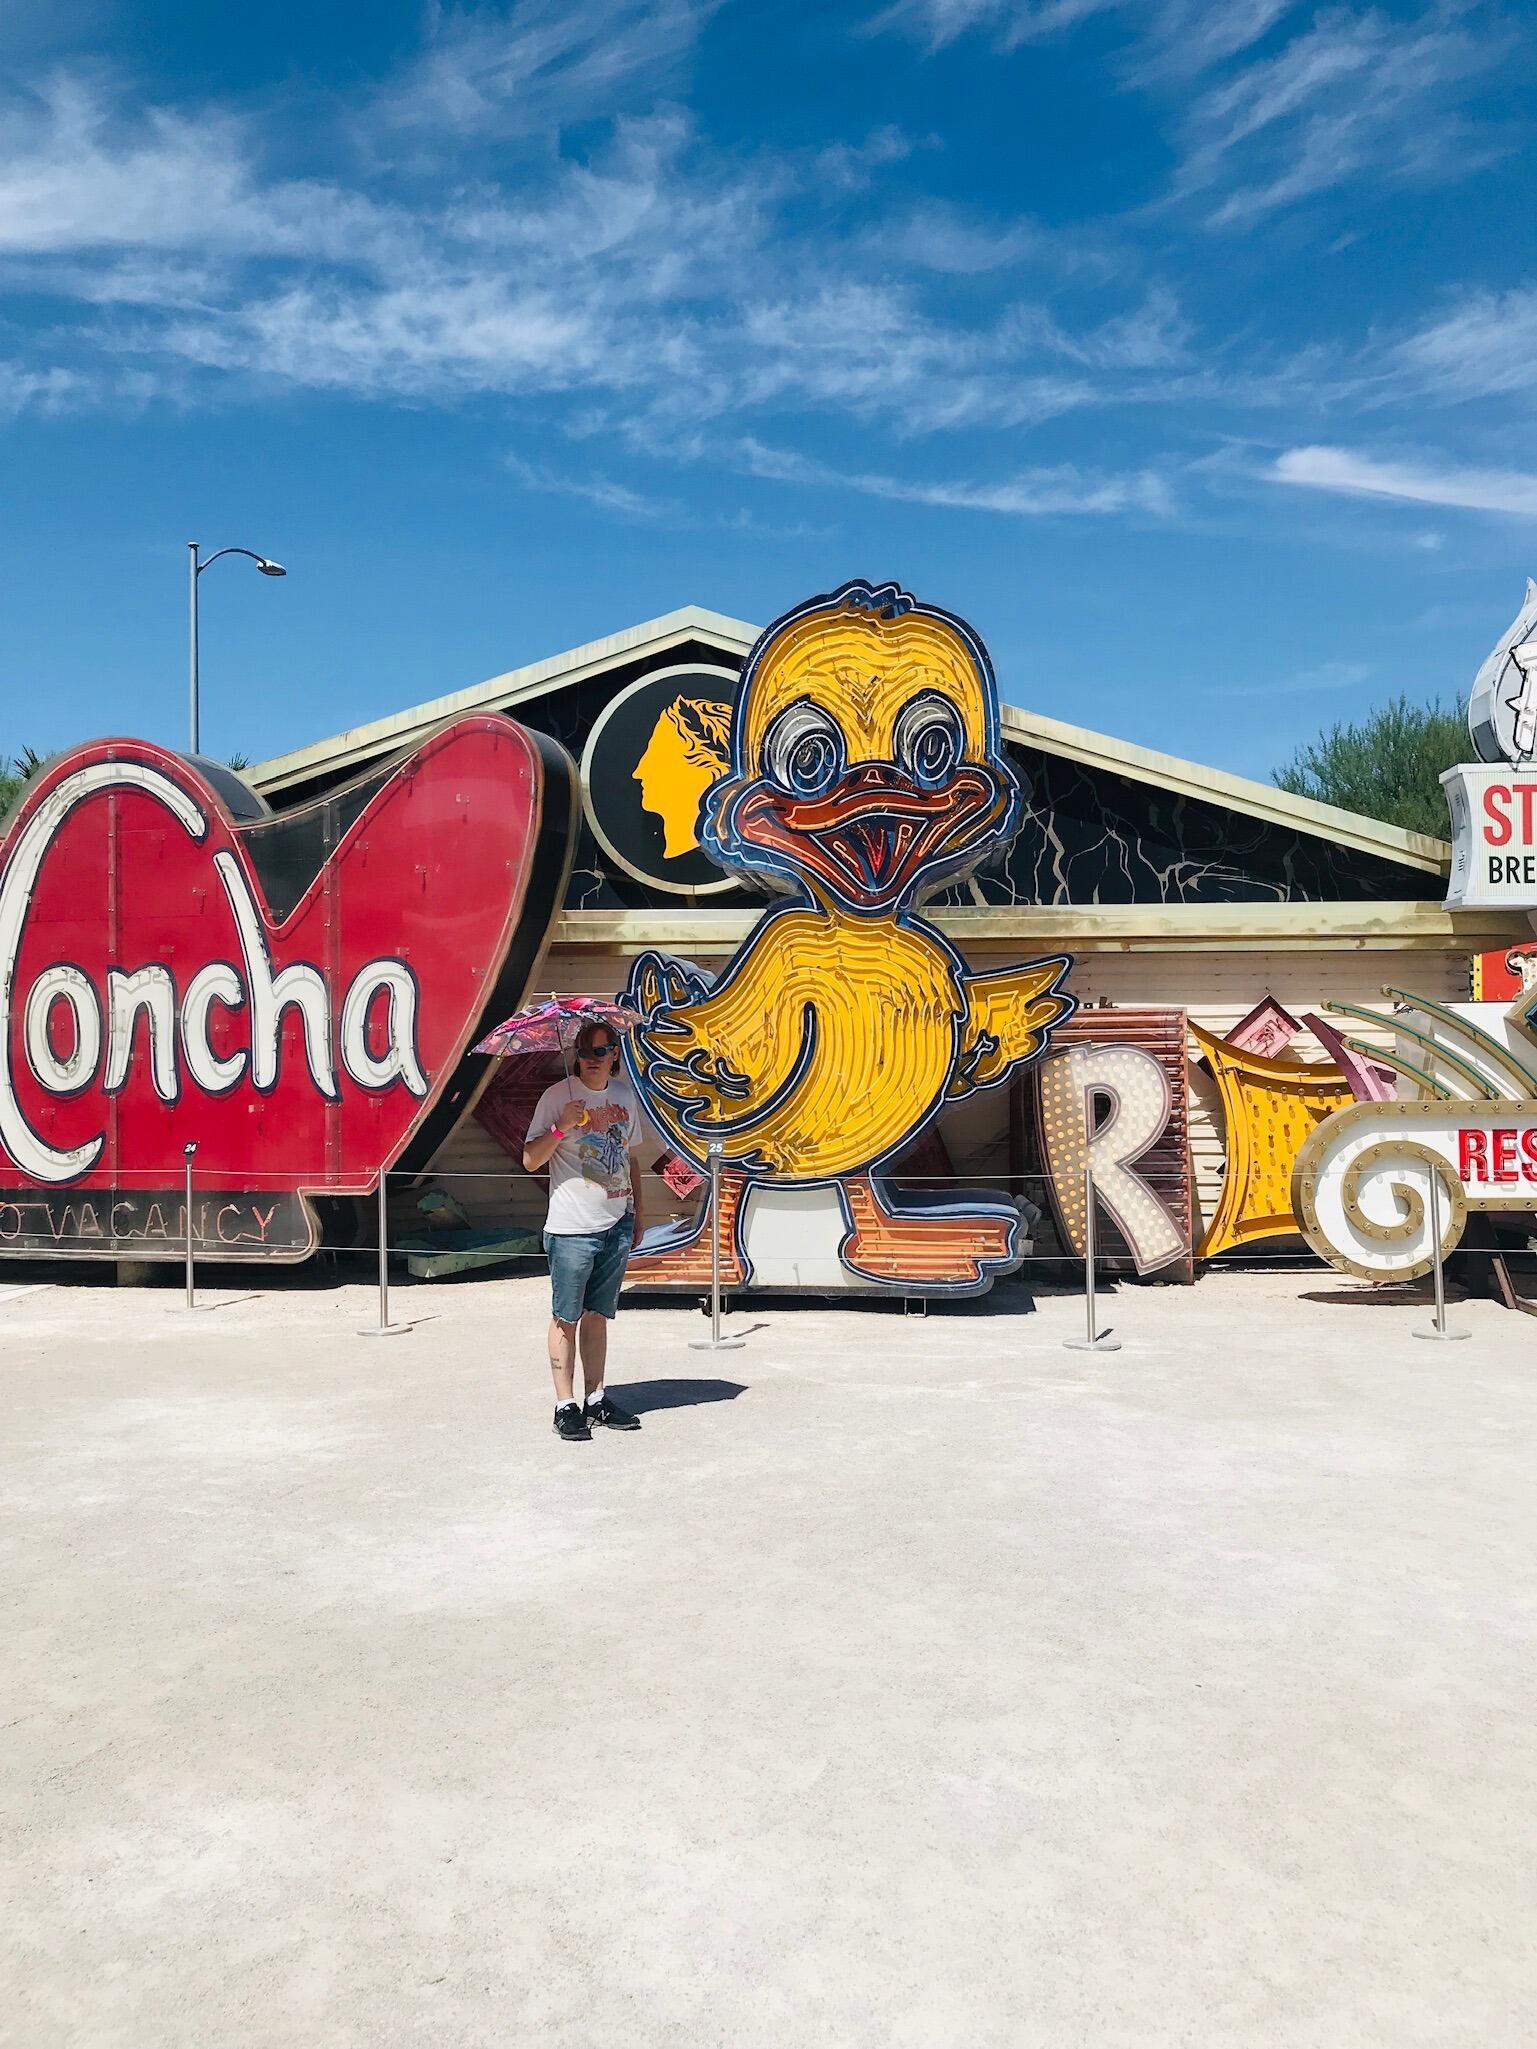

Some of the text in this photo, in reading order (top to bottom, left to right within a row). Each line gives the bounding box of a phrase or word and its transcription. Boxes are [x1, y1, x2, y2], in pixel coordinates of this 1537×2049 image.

[1483, 784, 1537, 846] ST
[1489, 856, 1536, 884] BRE
[0, 762, 428, 1182] Concha
[184, 1143, 197, 1153] 24
[709, 1143, 723, 1153] 25
[1033, 1042, 1192, 1276] R
[46, 1202, 280, 1243] VACANCY
